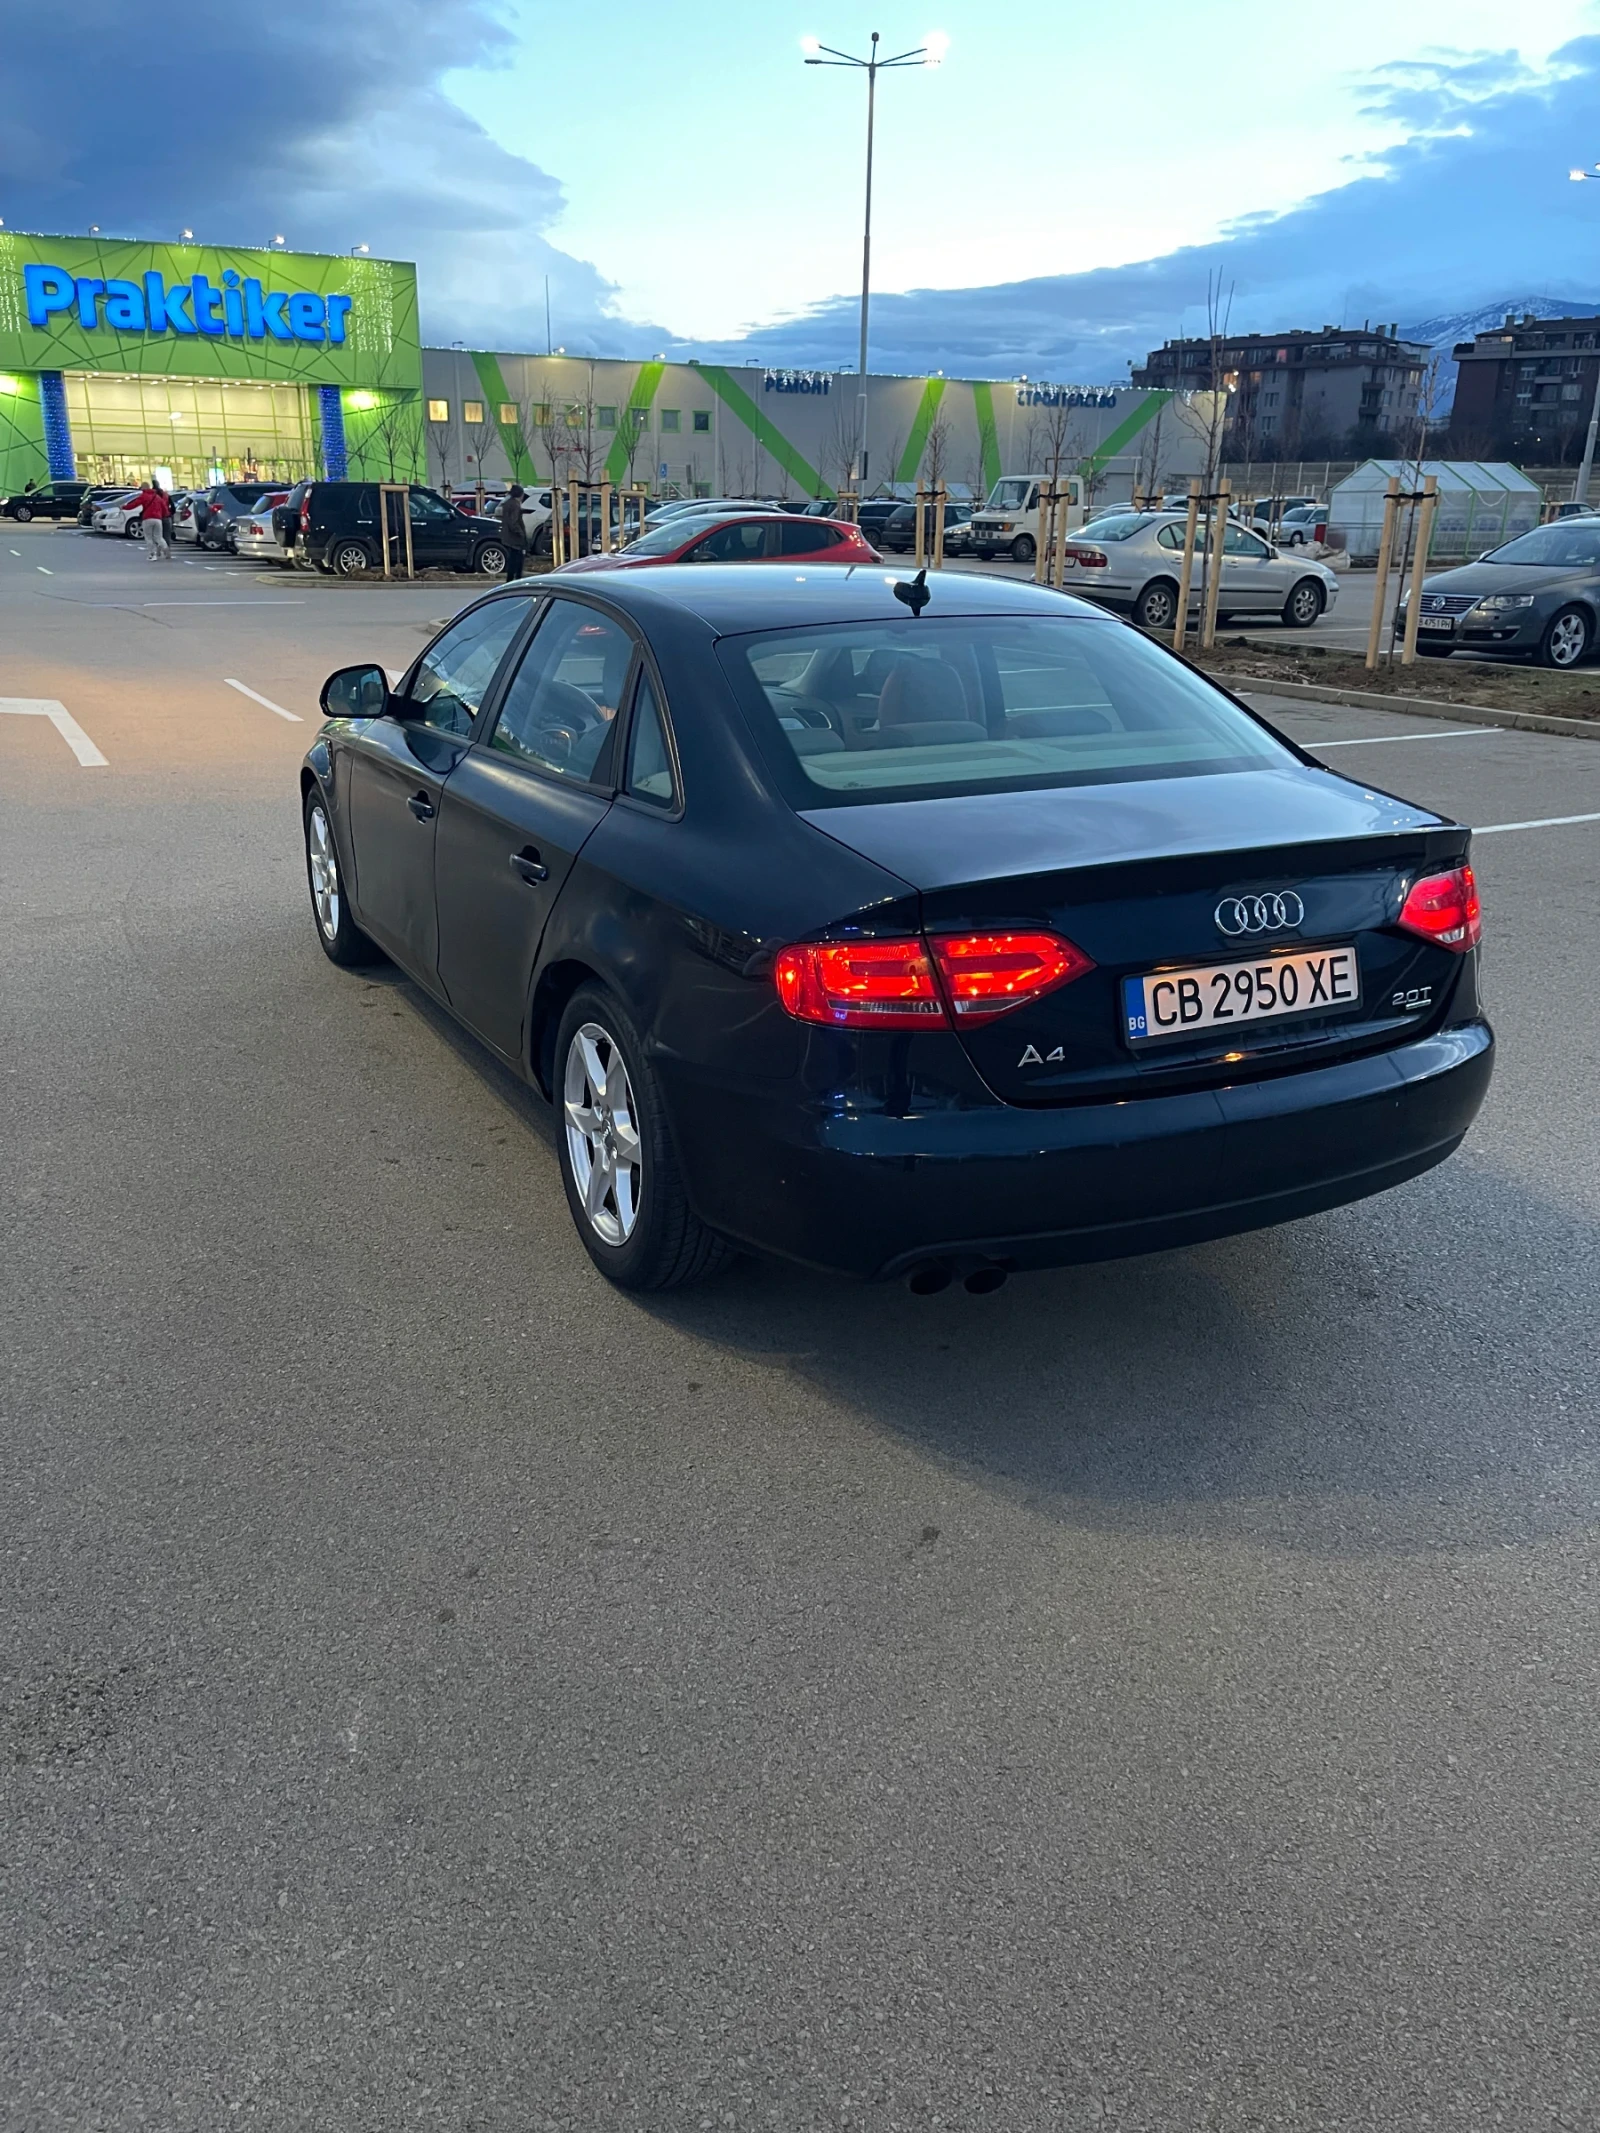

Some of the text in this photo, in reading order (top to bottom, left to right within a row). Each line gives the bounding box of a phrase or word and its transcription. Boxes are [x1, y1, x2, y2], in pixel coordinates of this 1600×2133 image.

[24, 263, 353, 342] Praktiker
[765, 376, 830, 395] РЕМОНТ
[1152, 955, 1352, 1026] CB 2950 XE
[1128, 1015, 1146, 1031] BG
[1017, 1044, 1066, 1068] A4
